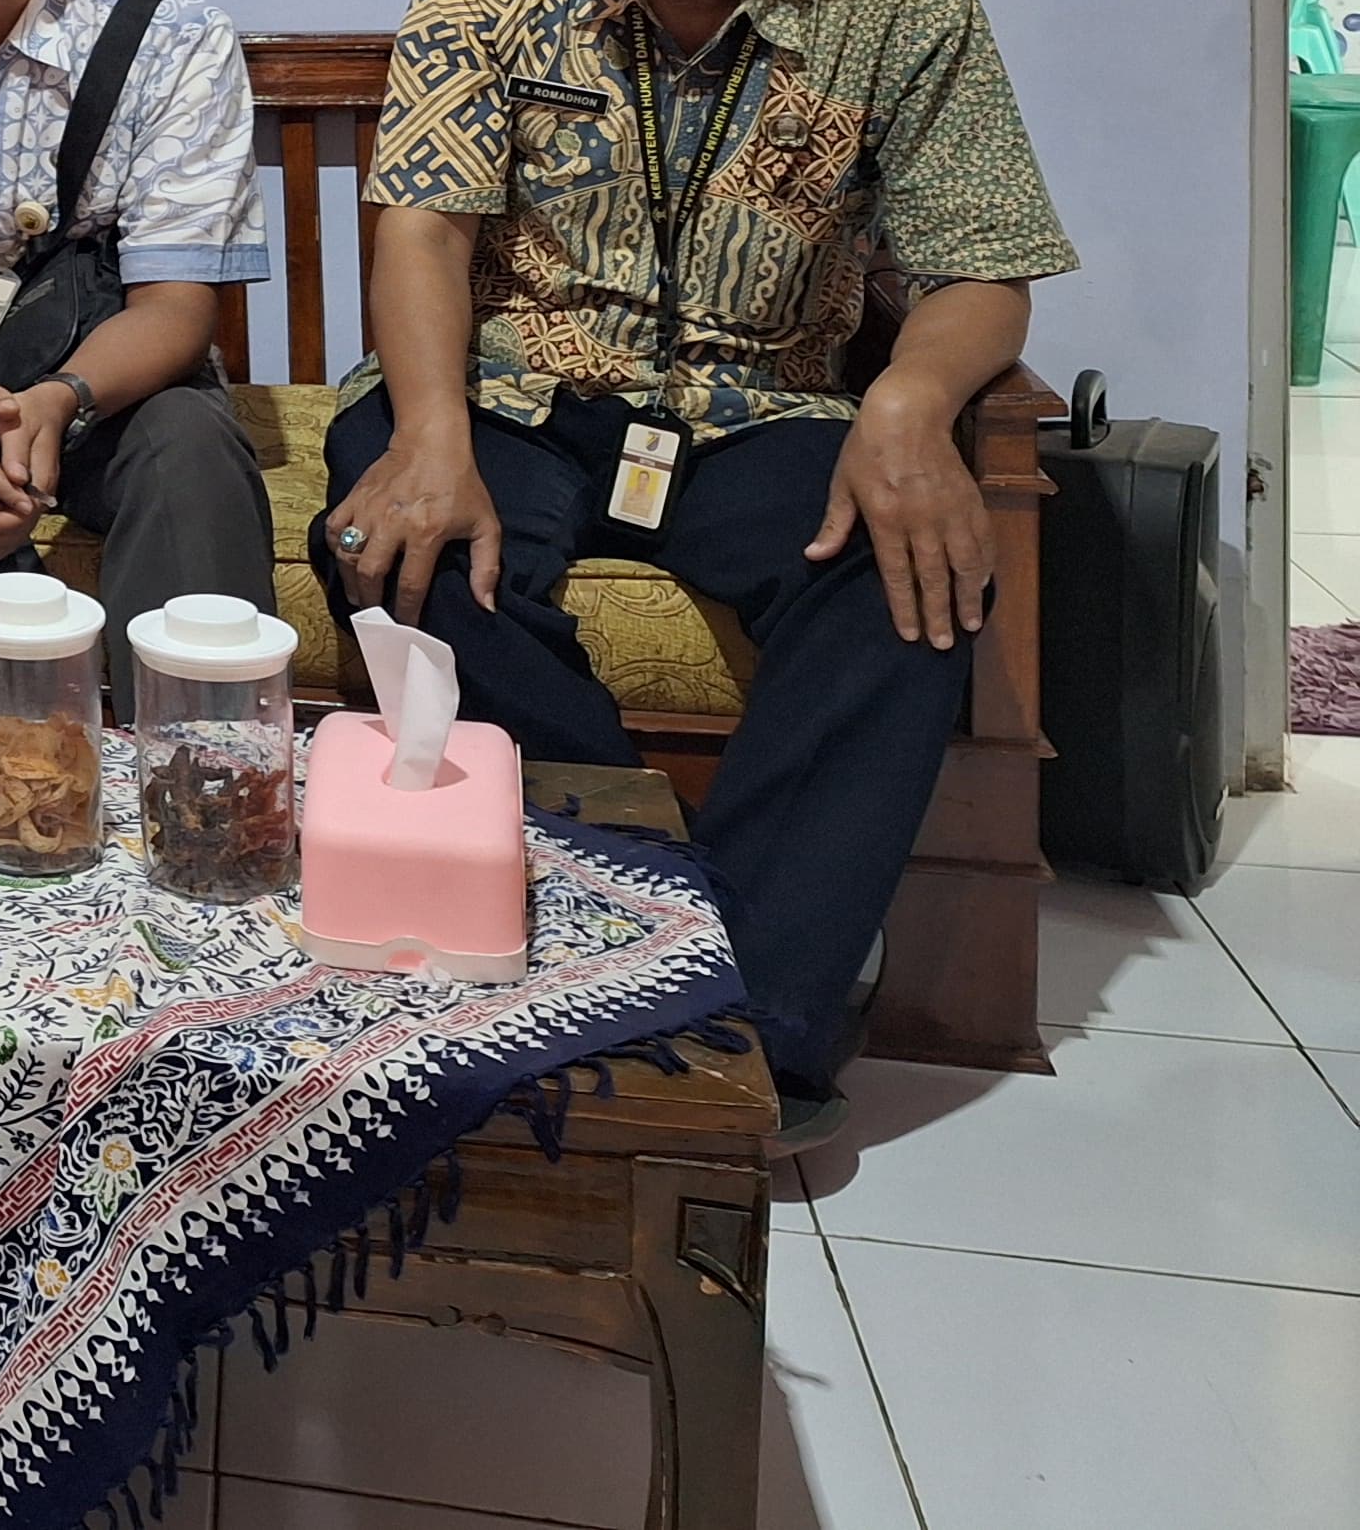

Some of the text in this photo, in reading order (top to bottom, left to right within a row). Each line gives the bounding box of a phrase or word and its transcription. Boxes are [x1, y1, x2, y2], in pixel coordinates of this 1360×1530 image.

[633, 33, 648, 59] DAN
[518, 84, 598, 108] M. ROMADHON
[636, 62, 653, 107] HUKUM
[703, 106, 729, 152] HUKUM
[640, 110, 663, 200] KEMENTERIAN
[695, 153, 713, 179] DAN
[683, 177, 703, 210] HAM
